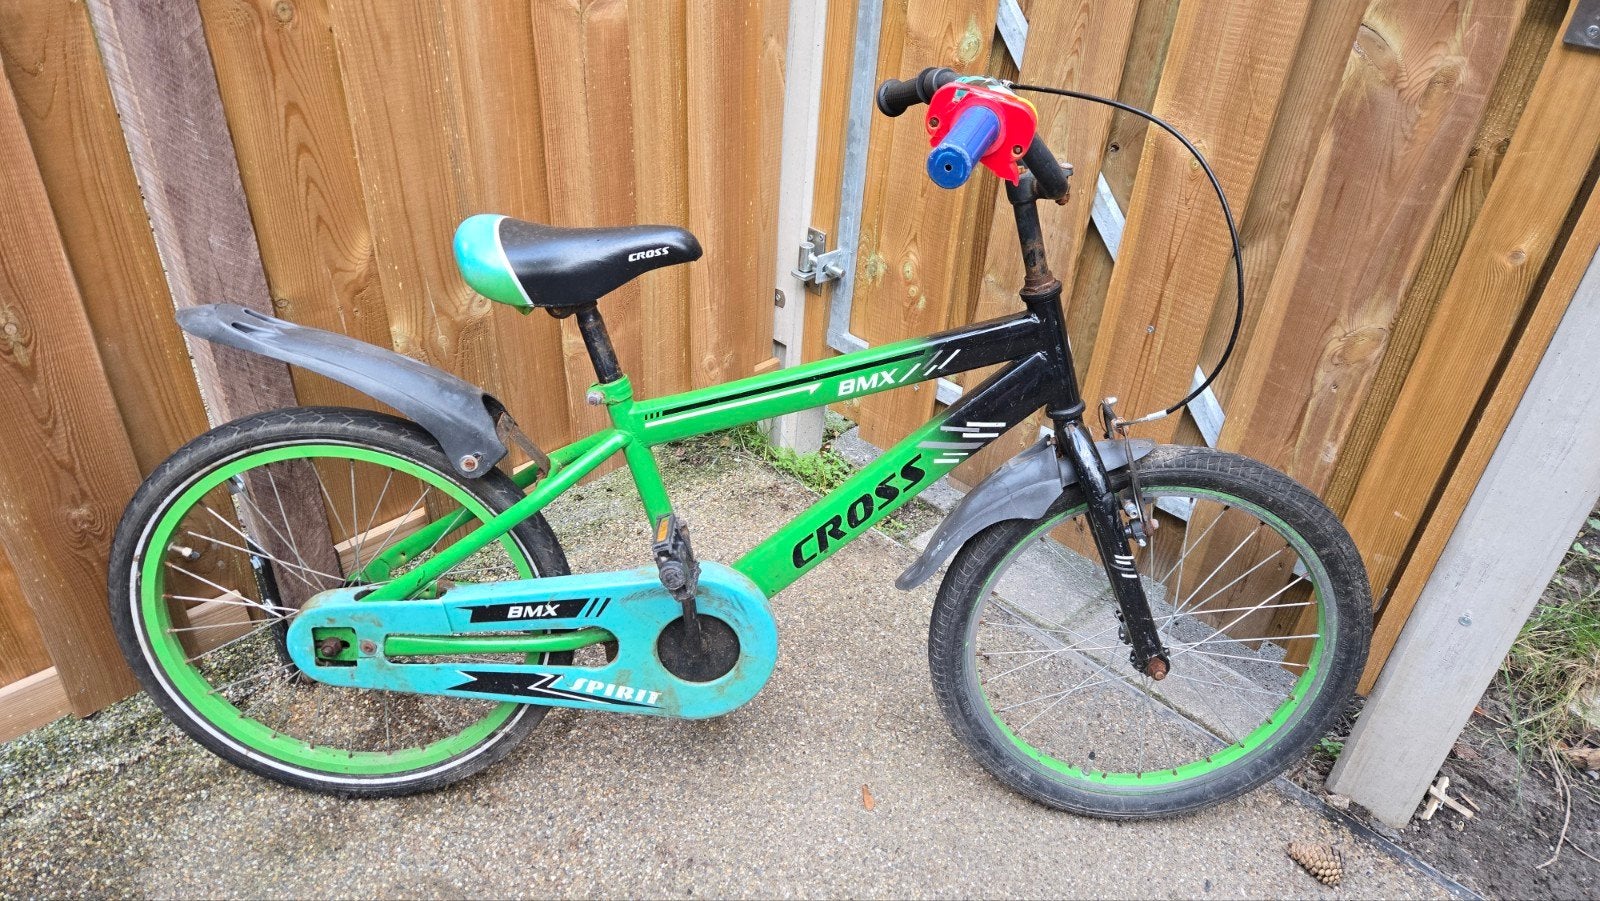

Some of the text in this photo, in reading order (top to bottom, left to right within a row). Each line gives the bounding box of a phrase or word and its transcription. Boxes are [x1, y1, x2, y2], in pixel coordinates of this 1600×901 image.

[628, 246, 670, 262] CROSS
[838, 368, 898, 396] BMX
[792, 453, 926, 569] CROSS
[507, 603, 560, 619] BMX
[569, 677, 663, 704] SPIRIT
